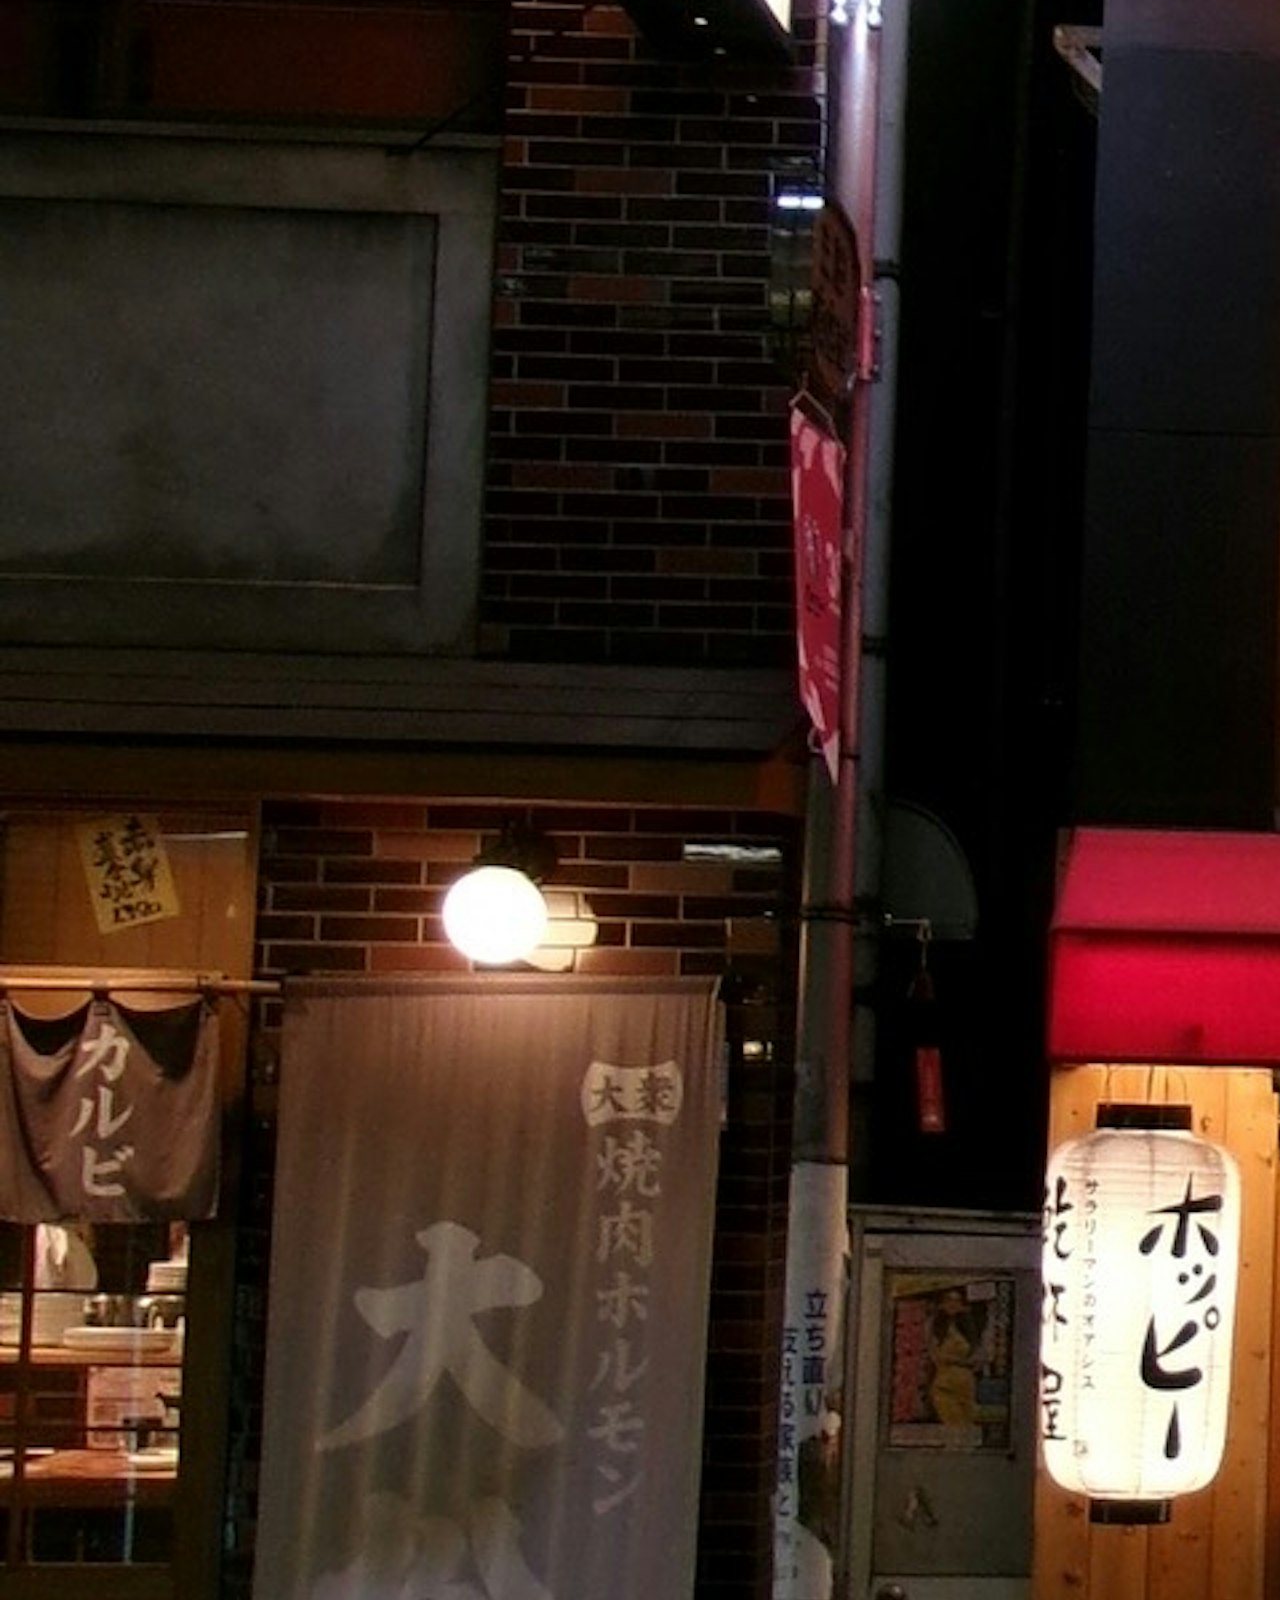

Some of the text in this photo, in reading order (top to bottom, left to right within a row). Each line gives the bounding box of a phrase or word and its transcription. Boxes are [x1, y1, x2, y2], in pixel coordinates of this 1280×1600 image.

[70, 1020, 137, 1197] カルビ
[588, 1130, 663, 1514] 焼肉ホルモン
[803, 1291, 829, 1418] 立ち直り
[1136, 1168, 1224, 1460] ホッピー
